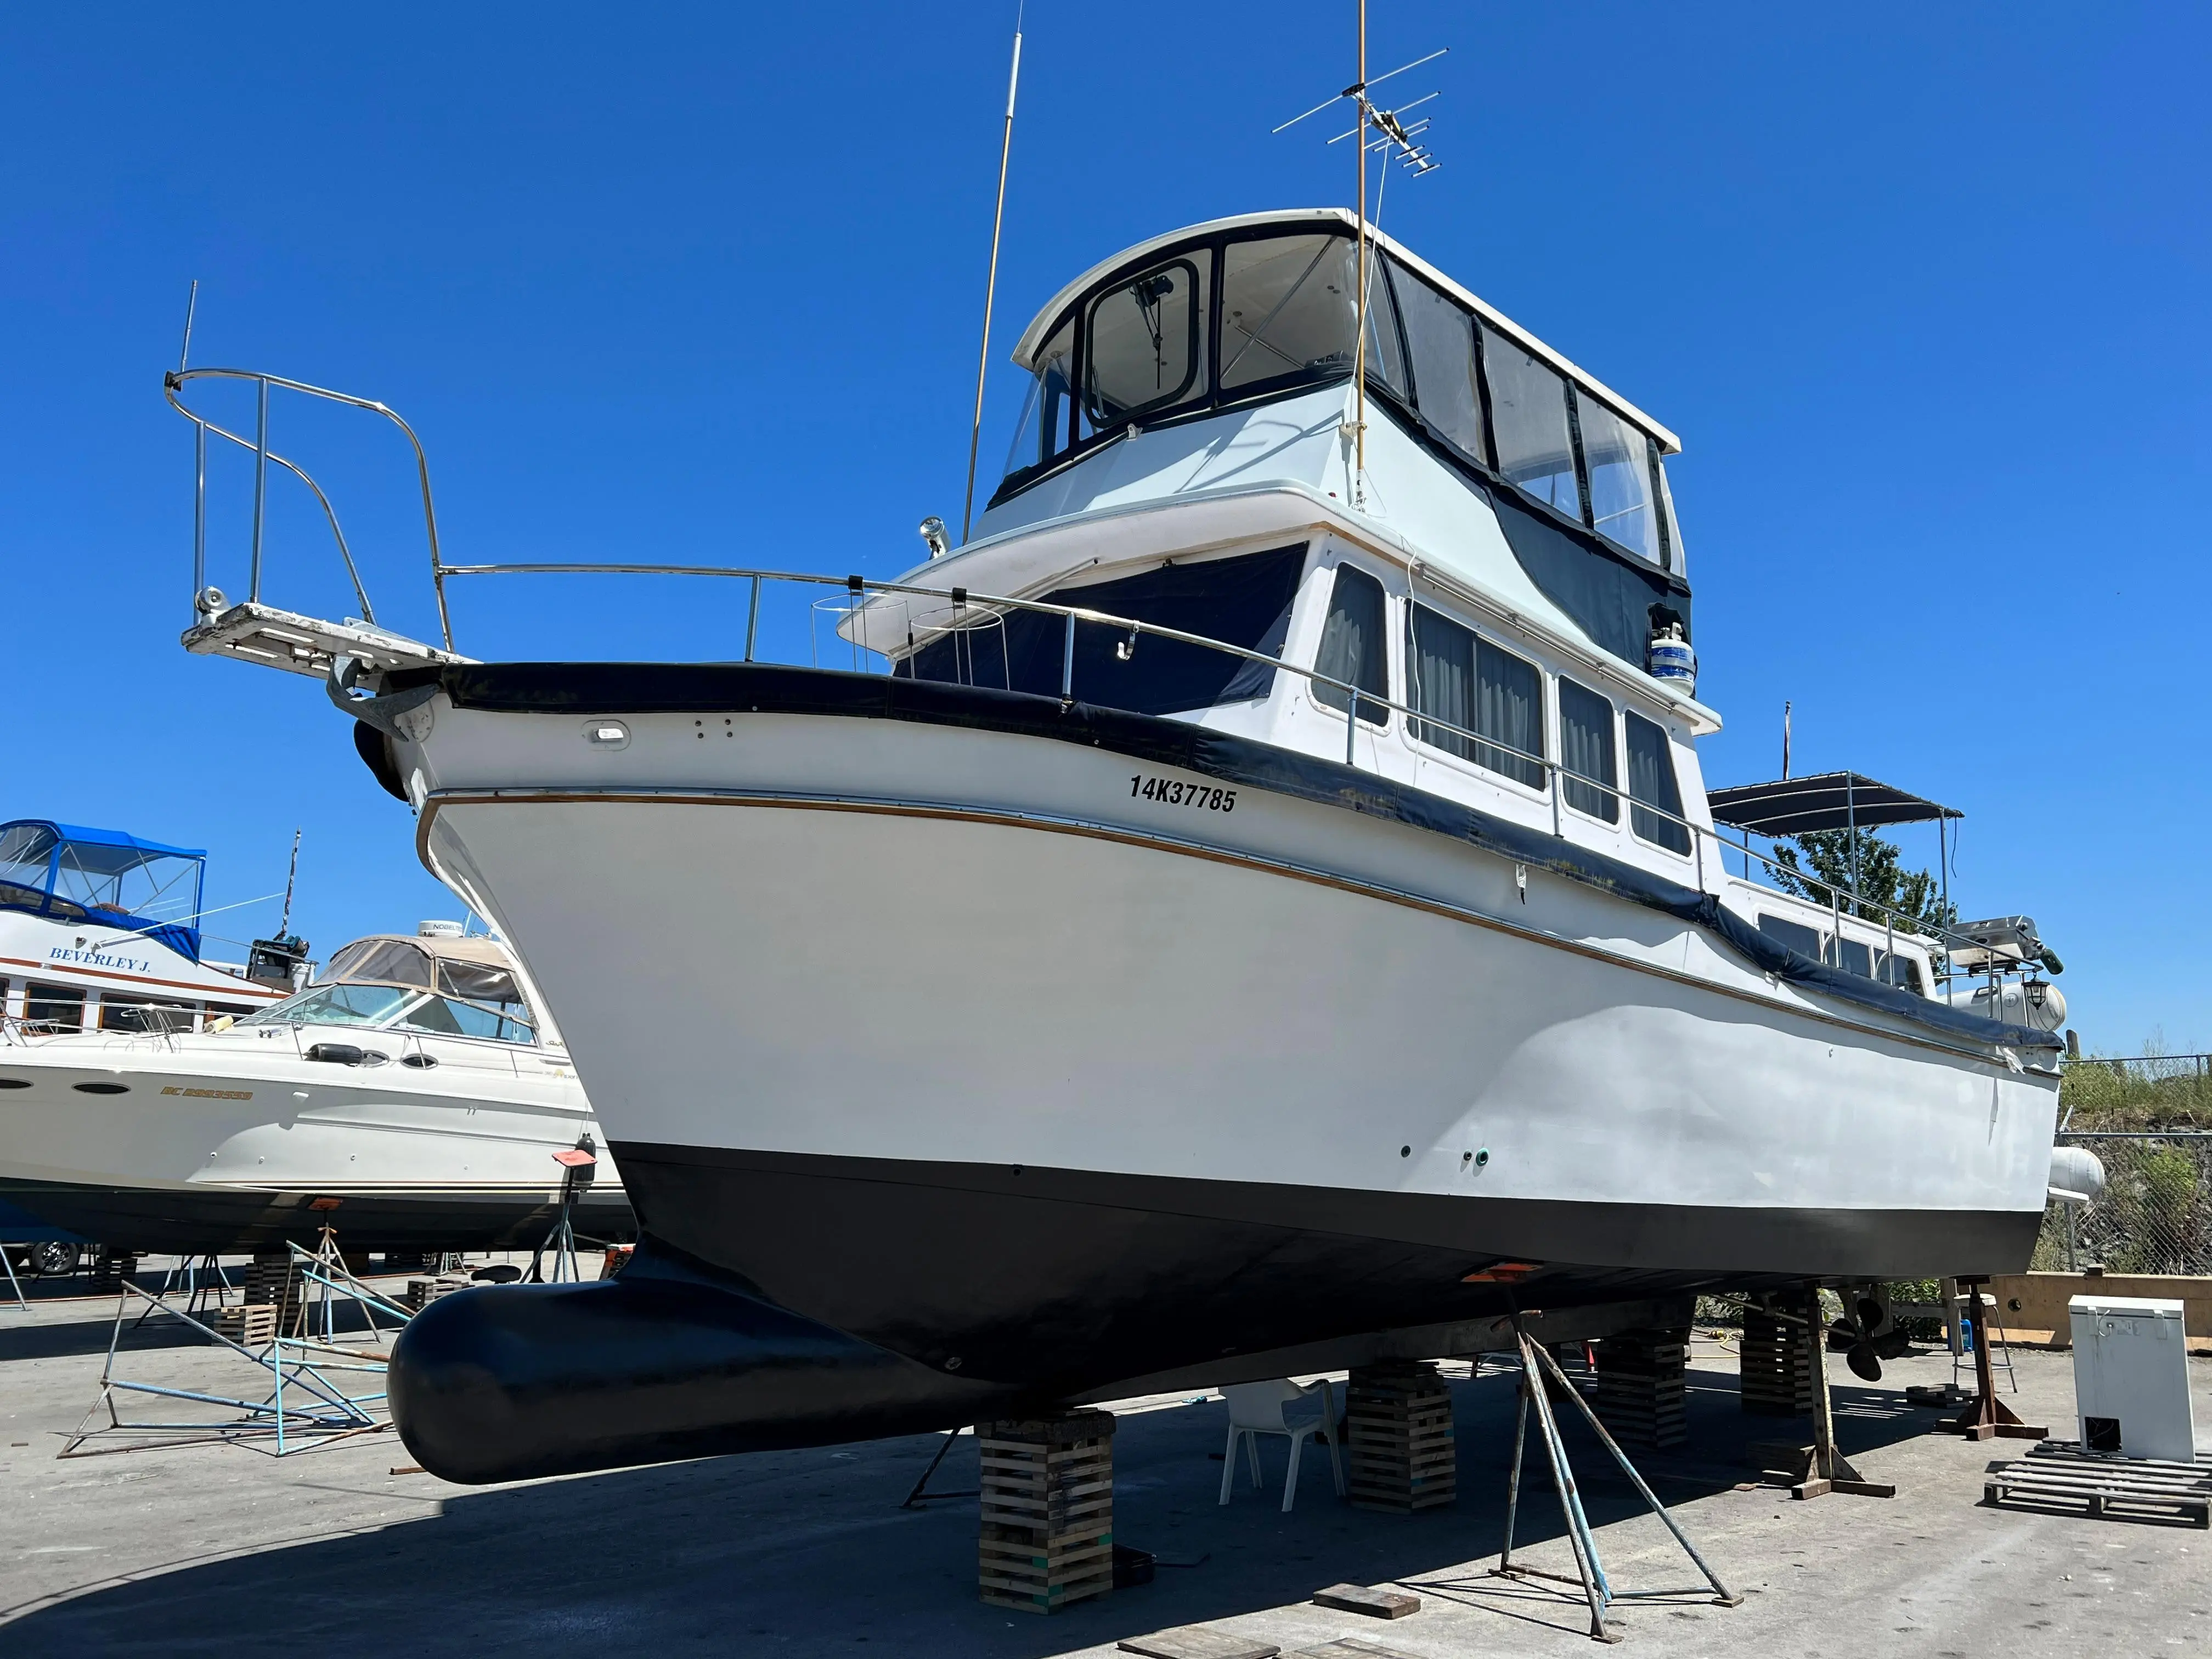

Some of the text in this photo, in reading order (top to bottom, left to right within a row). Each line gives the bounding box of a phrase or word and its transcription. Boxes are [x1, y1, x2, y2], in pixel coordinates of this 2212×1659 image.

[1131, 775, 1237, 812] 14K37785
[49, 947, 150, 972] BEVERLEY J.
[161, 1086, 183, 1095] BC
